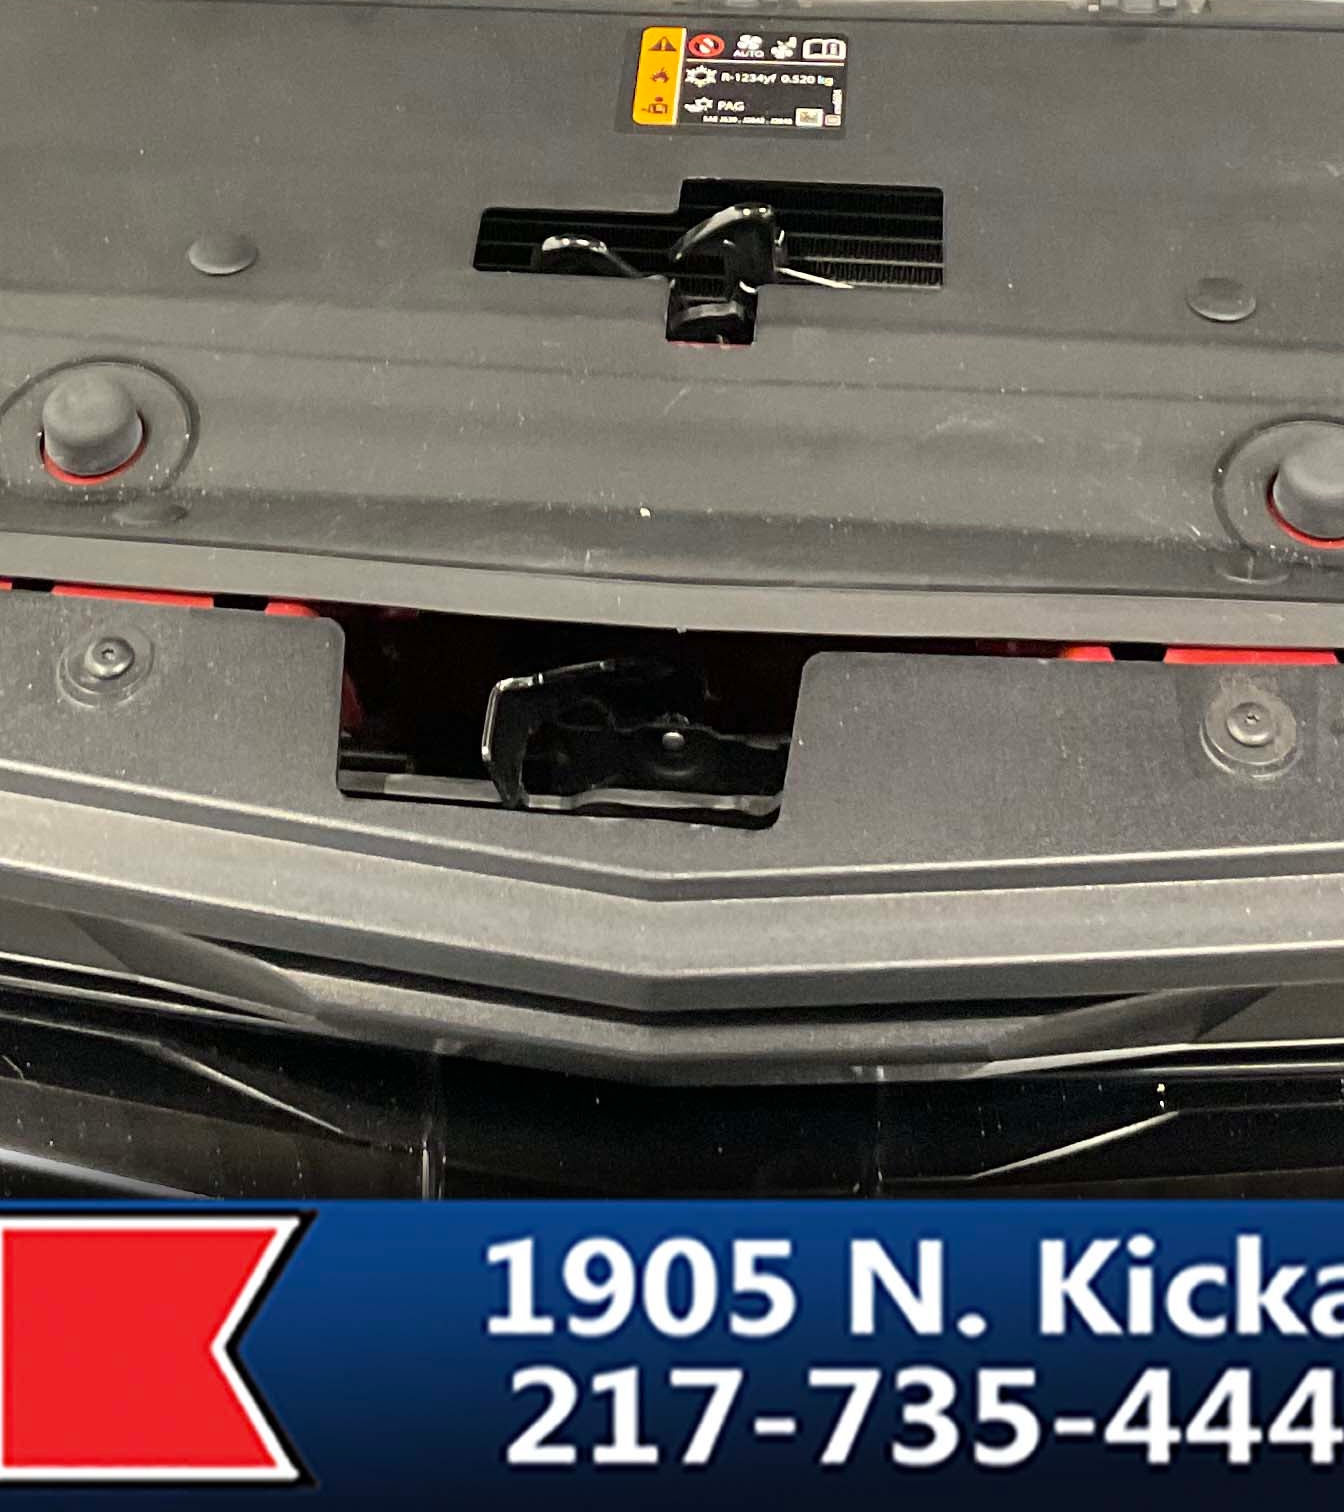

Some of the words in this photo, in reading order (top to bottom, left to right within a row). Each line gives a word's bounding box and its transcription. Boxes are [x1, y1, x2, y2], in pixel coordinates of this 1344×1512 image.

[732, 49, 765, 58] AUTO
[720, 71, 777, 85] R-1234yf
[780, 74, 816, 85] 0.520
[817, 75, 834, 87] kg
[717, 100, 745, 112] PAG
